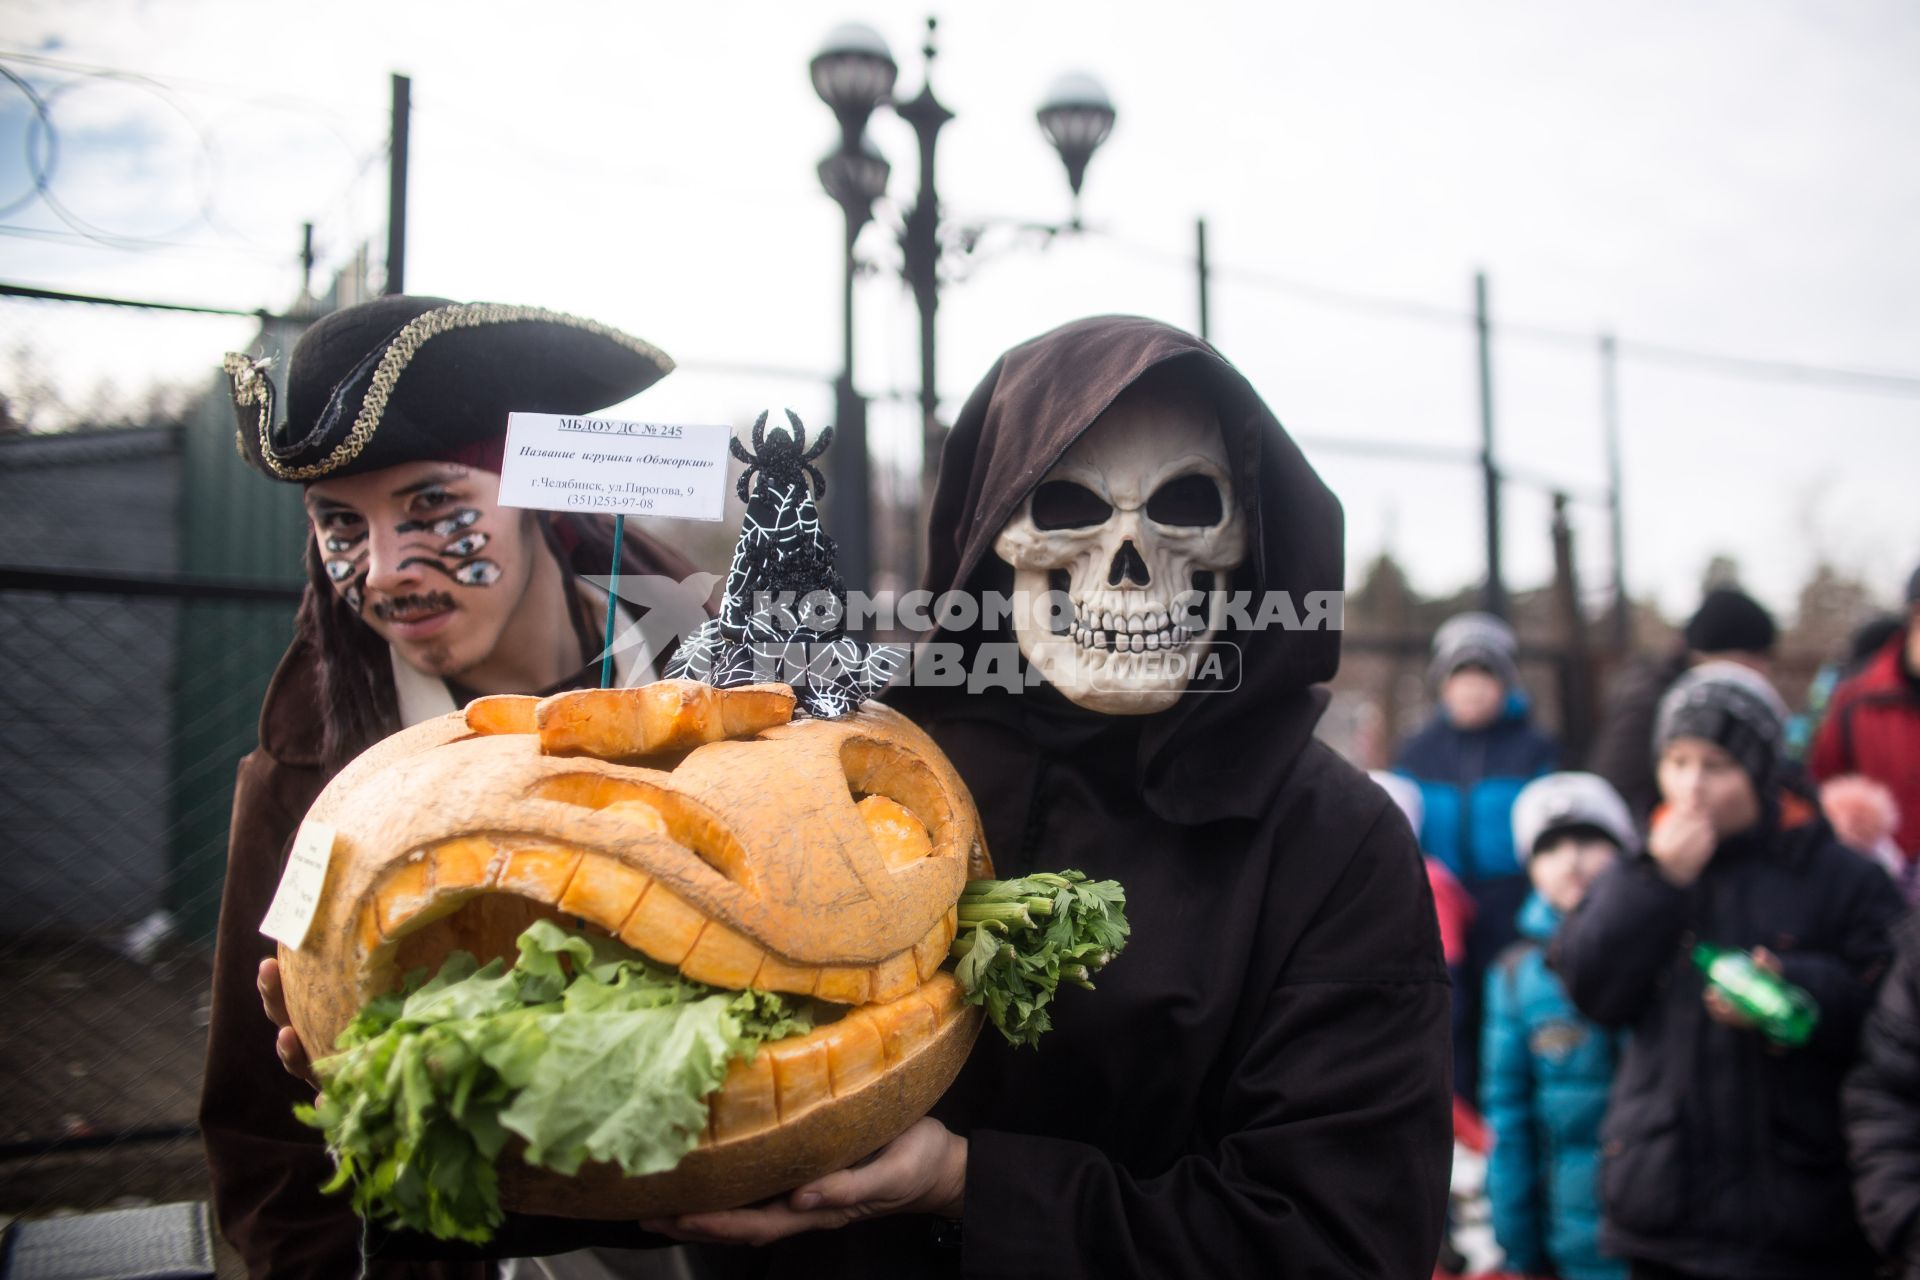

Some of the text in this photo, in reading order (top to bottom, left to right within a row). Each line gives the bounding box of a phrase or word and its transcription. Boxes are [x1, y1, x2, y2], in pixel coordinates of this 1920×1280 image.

[559, 418, 683, 437] МБДОУ ДС № 245
[519, 446, 714, 469] Название игрушки «Обжоркин»
[531, 477, 694, 498] г.Челябинск, ул.Пирогова, 9
[567, 495, 654, 510] (351)253-97-08
